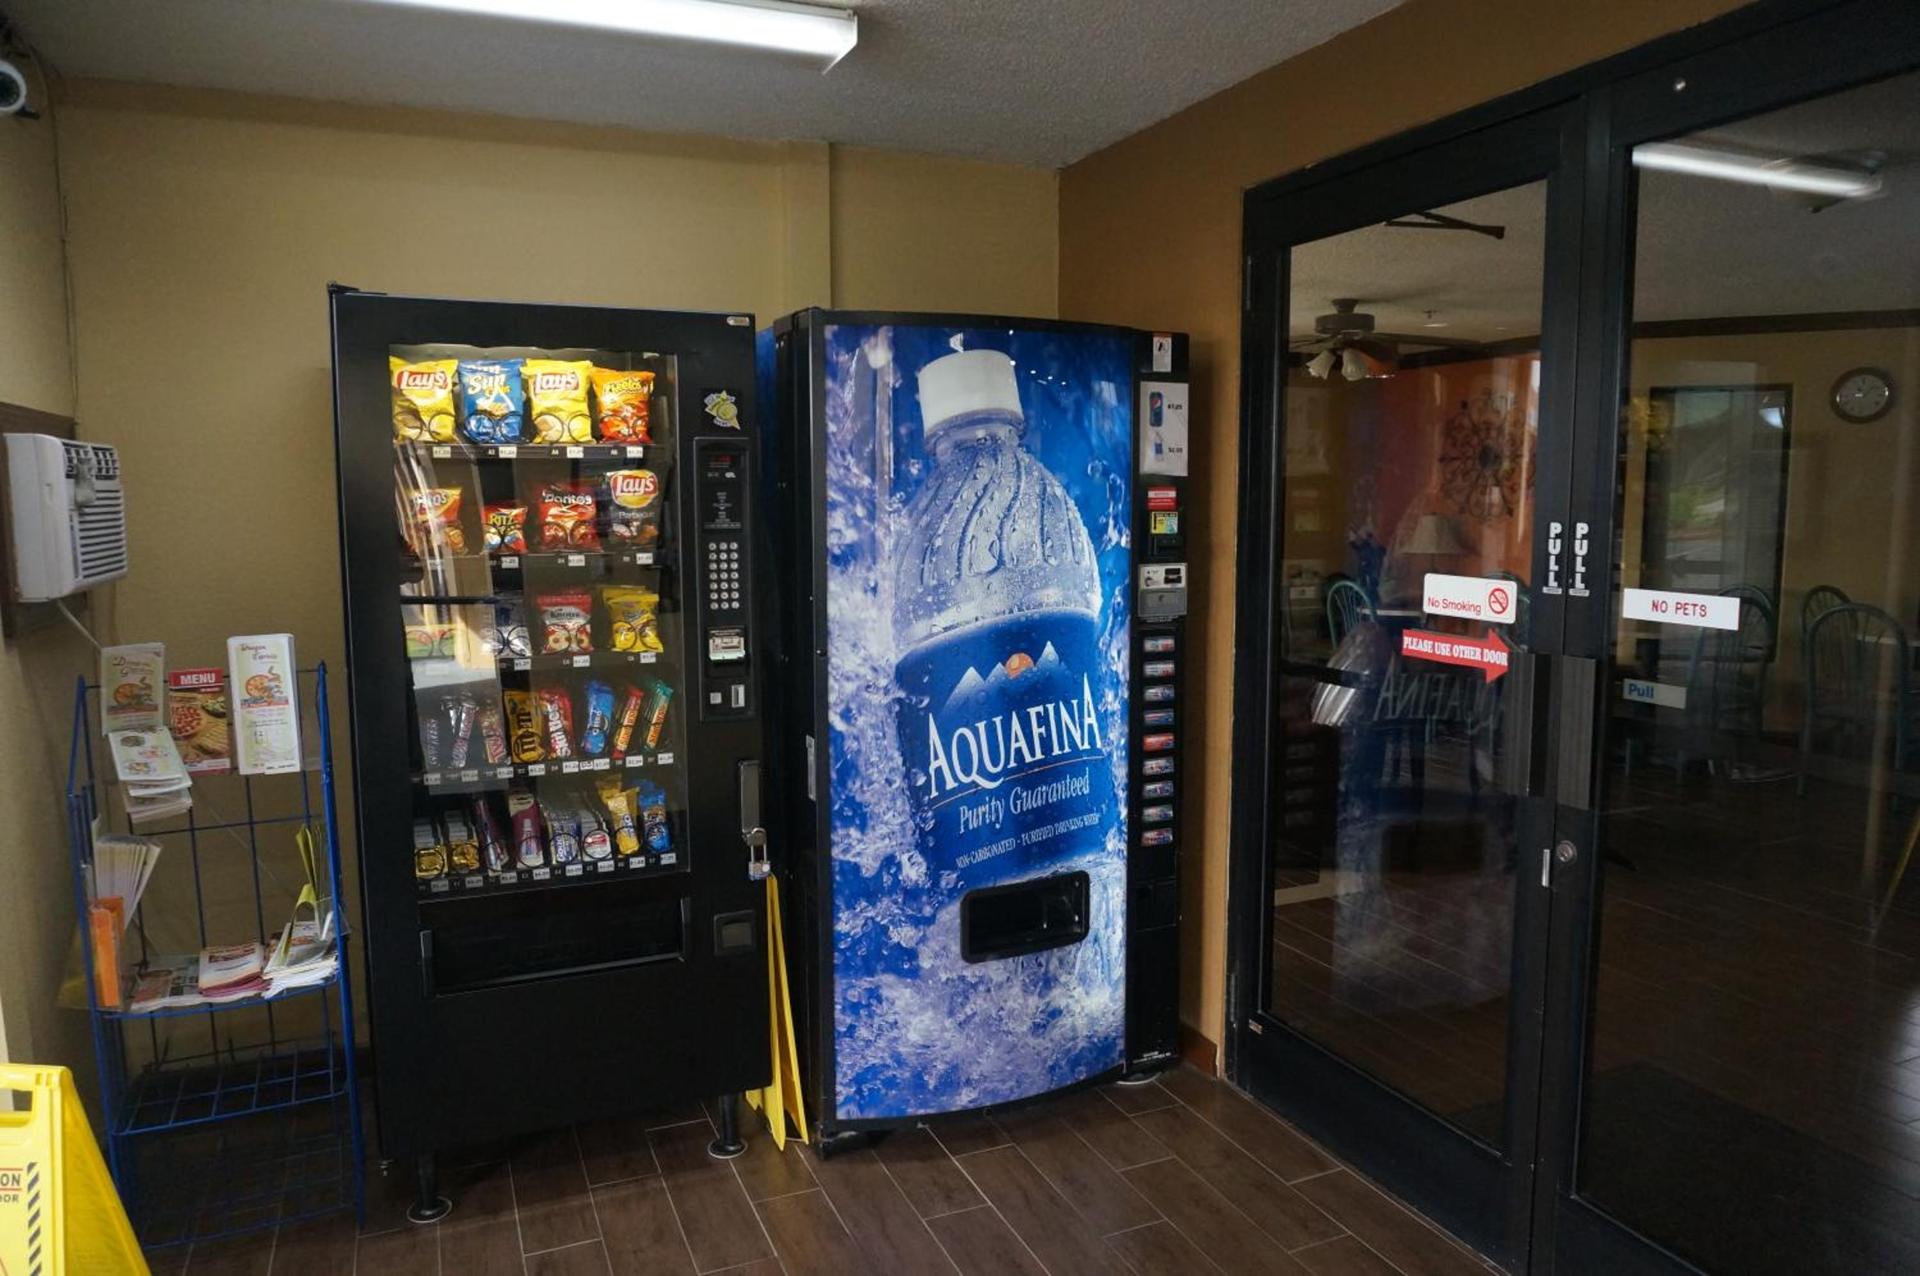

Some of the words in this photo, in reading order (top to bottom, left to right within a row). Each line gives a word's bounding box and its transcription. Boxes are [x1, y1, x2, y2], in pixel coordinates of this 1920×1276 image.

[1548, 522, 1562, 587] PULL
[1575, 522, 1589, 589] PULL
[1428, 596, 1440, 608] No
[1442, 598, 1481, 616] Smoking
[1652, 600, 1669, 614] NO
[1675, 602, 1708, 617] PETS
[1403, 636, 1434, 653] PLEASE
[1434, 641, 1452, 657] USE
[1453, 645, 1482, 661] OTHER
[1483, 648, 1508, 666] DOOR
[180, 673, 216, 684] MENU
[1628, 683, 1655, 699] Pull
[929, 672, 1101, 799] AQUAFINA
[960, 794, 1005, 835] Purity
[1010, 766, 1090, 815] Guaranteed
[0, 1194, 19, 1203] OR
